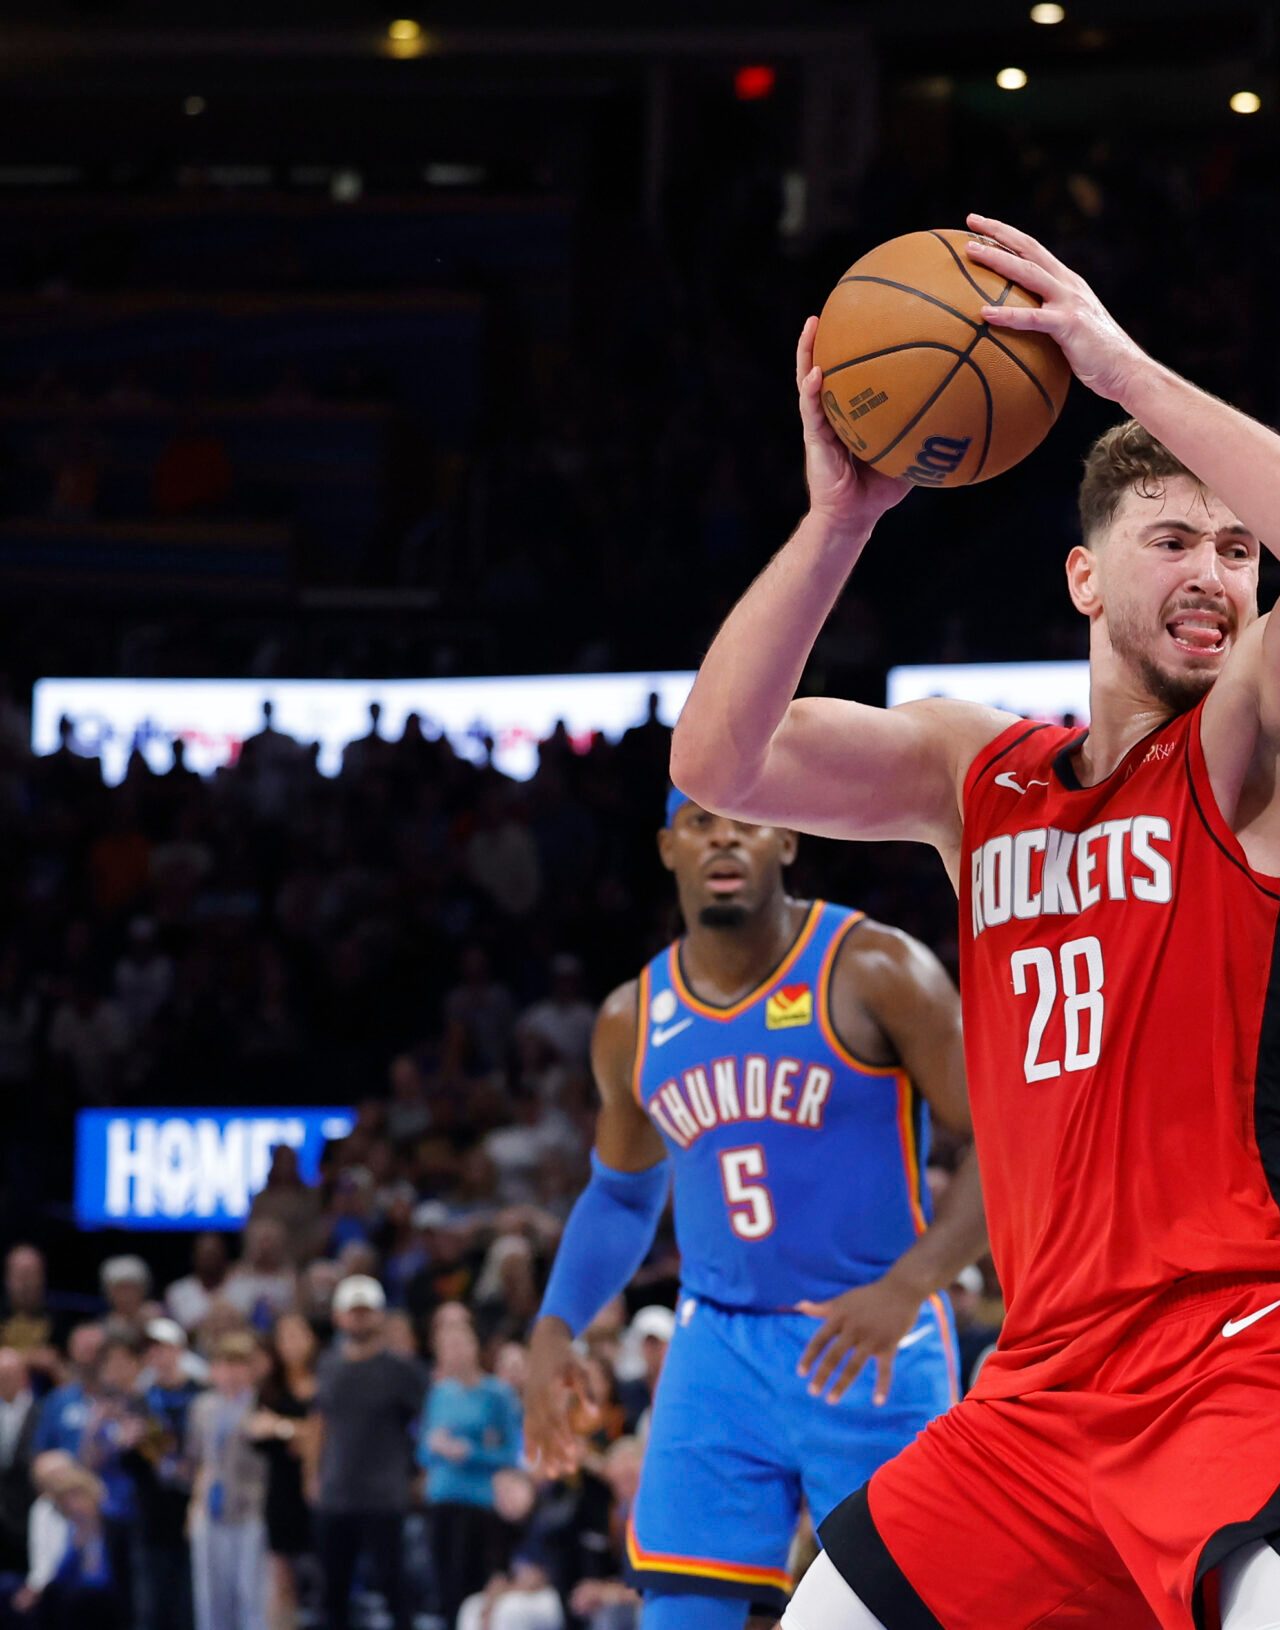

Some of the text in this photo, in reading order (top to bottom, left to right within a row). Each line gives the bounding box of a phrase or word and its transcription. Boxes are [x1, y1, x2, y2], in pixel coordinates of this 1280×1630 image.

[972, 815, 1174, 940] ROCKETS
[1010, 936, 1105, 1084] 28
[647, 1053, 834, 1151] THUNDER
[718, 1143, 776, 1242] 5
